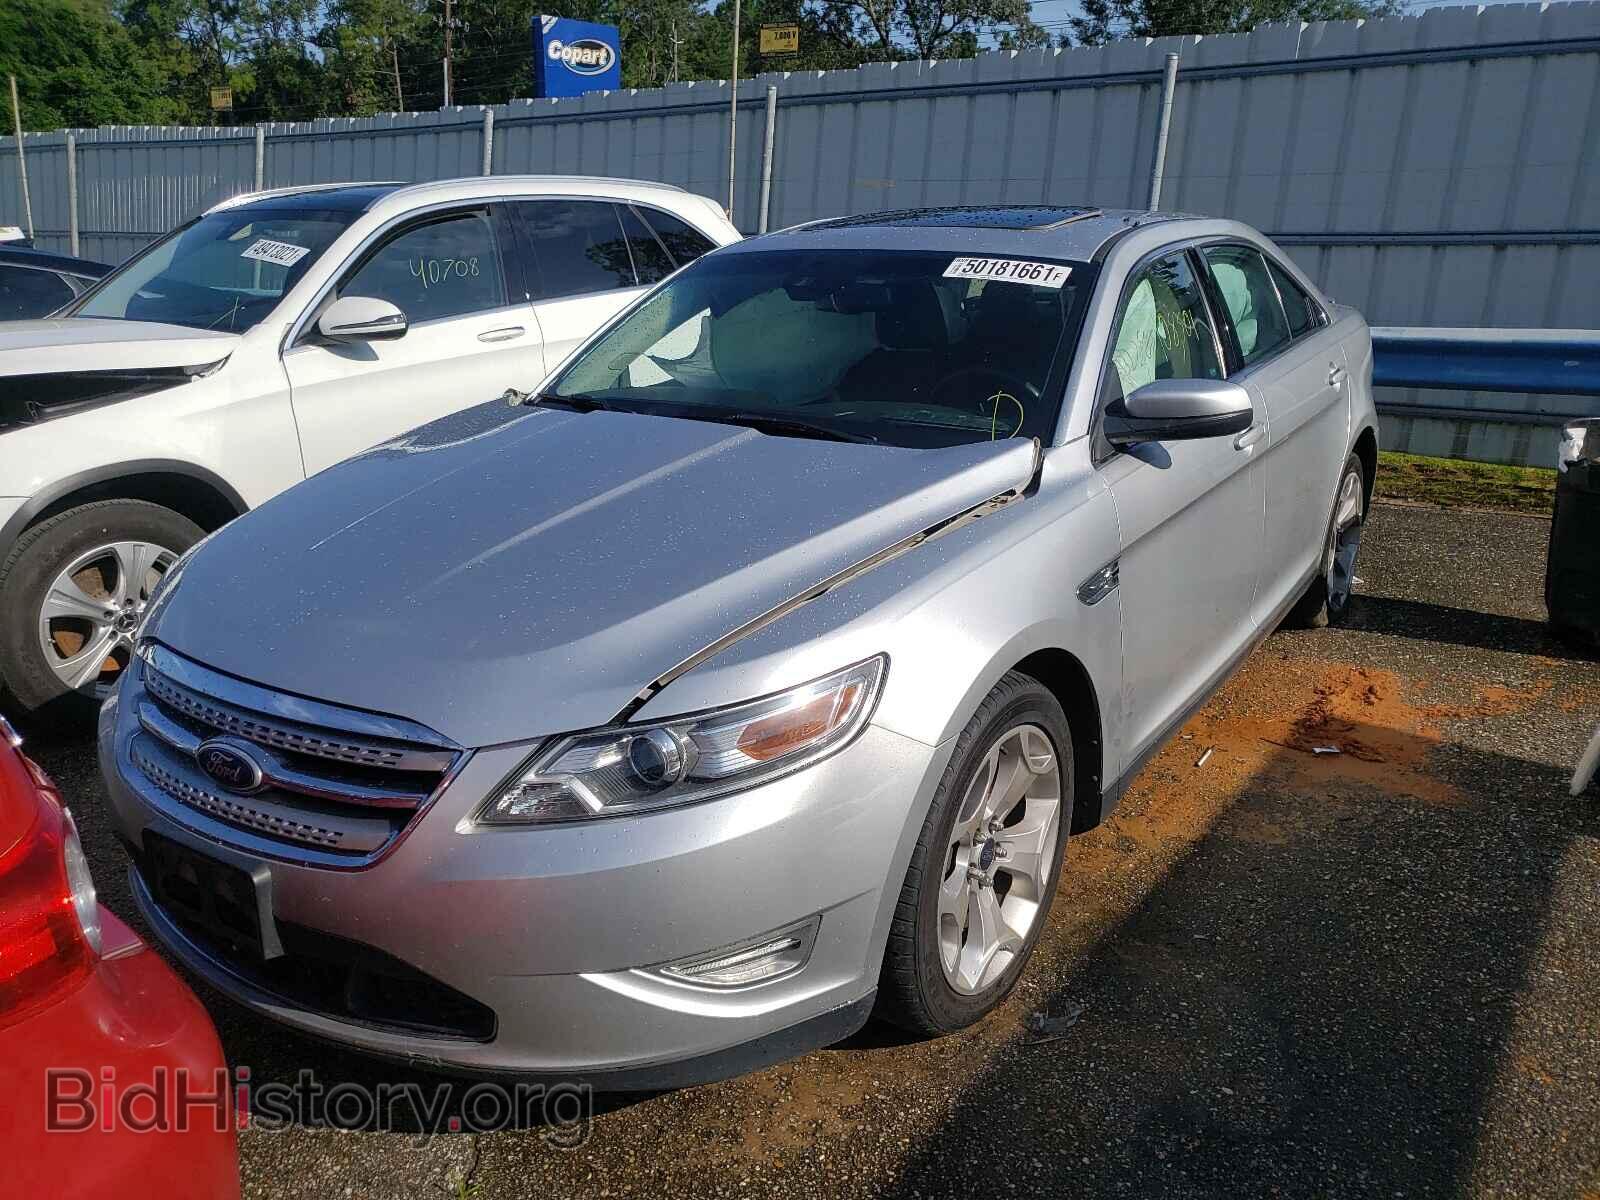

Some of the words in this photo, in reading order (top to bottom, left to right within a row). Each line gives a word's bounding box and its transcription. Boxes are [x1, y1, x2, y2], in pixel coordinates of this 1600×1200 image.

[548, 40, 608, 67] Copart
[409, 257, 480, 288] 40708
[962, 259, 1055, 281] 50181661
[207, 751, 241, 781] Ford
